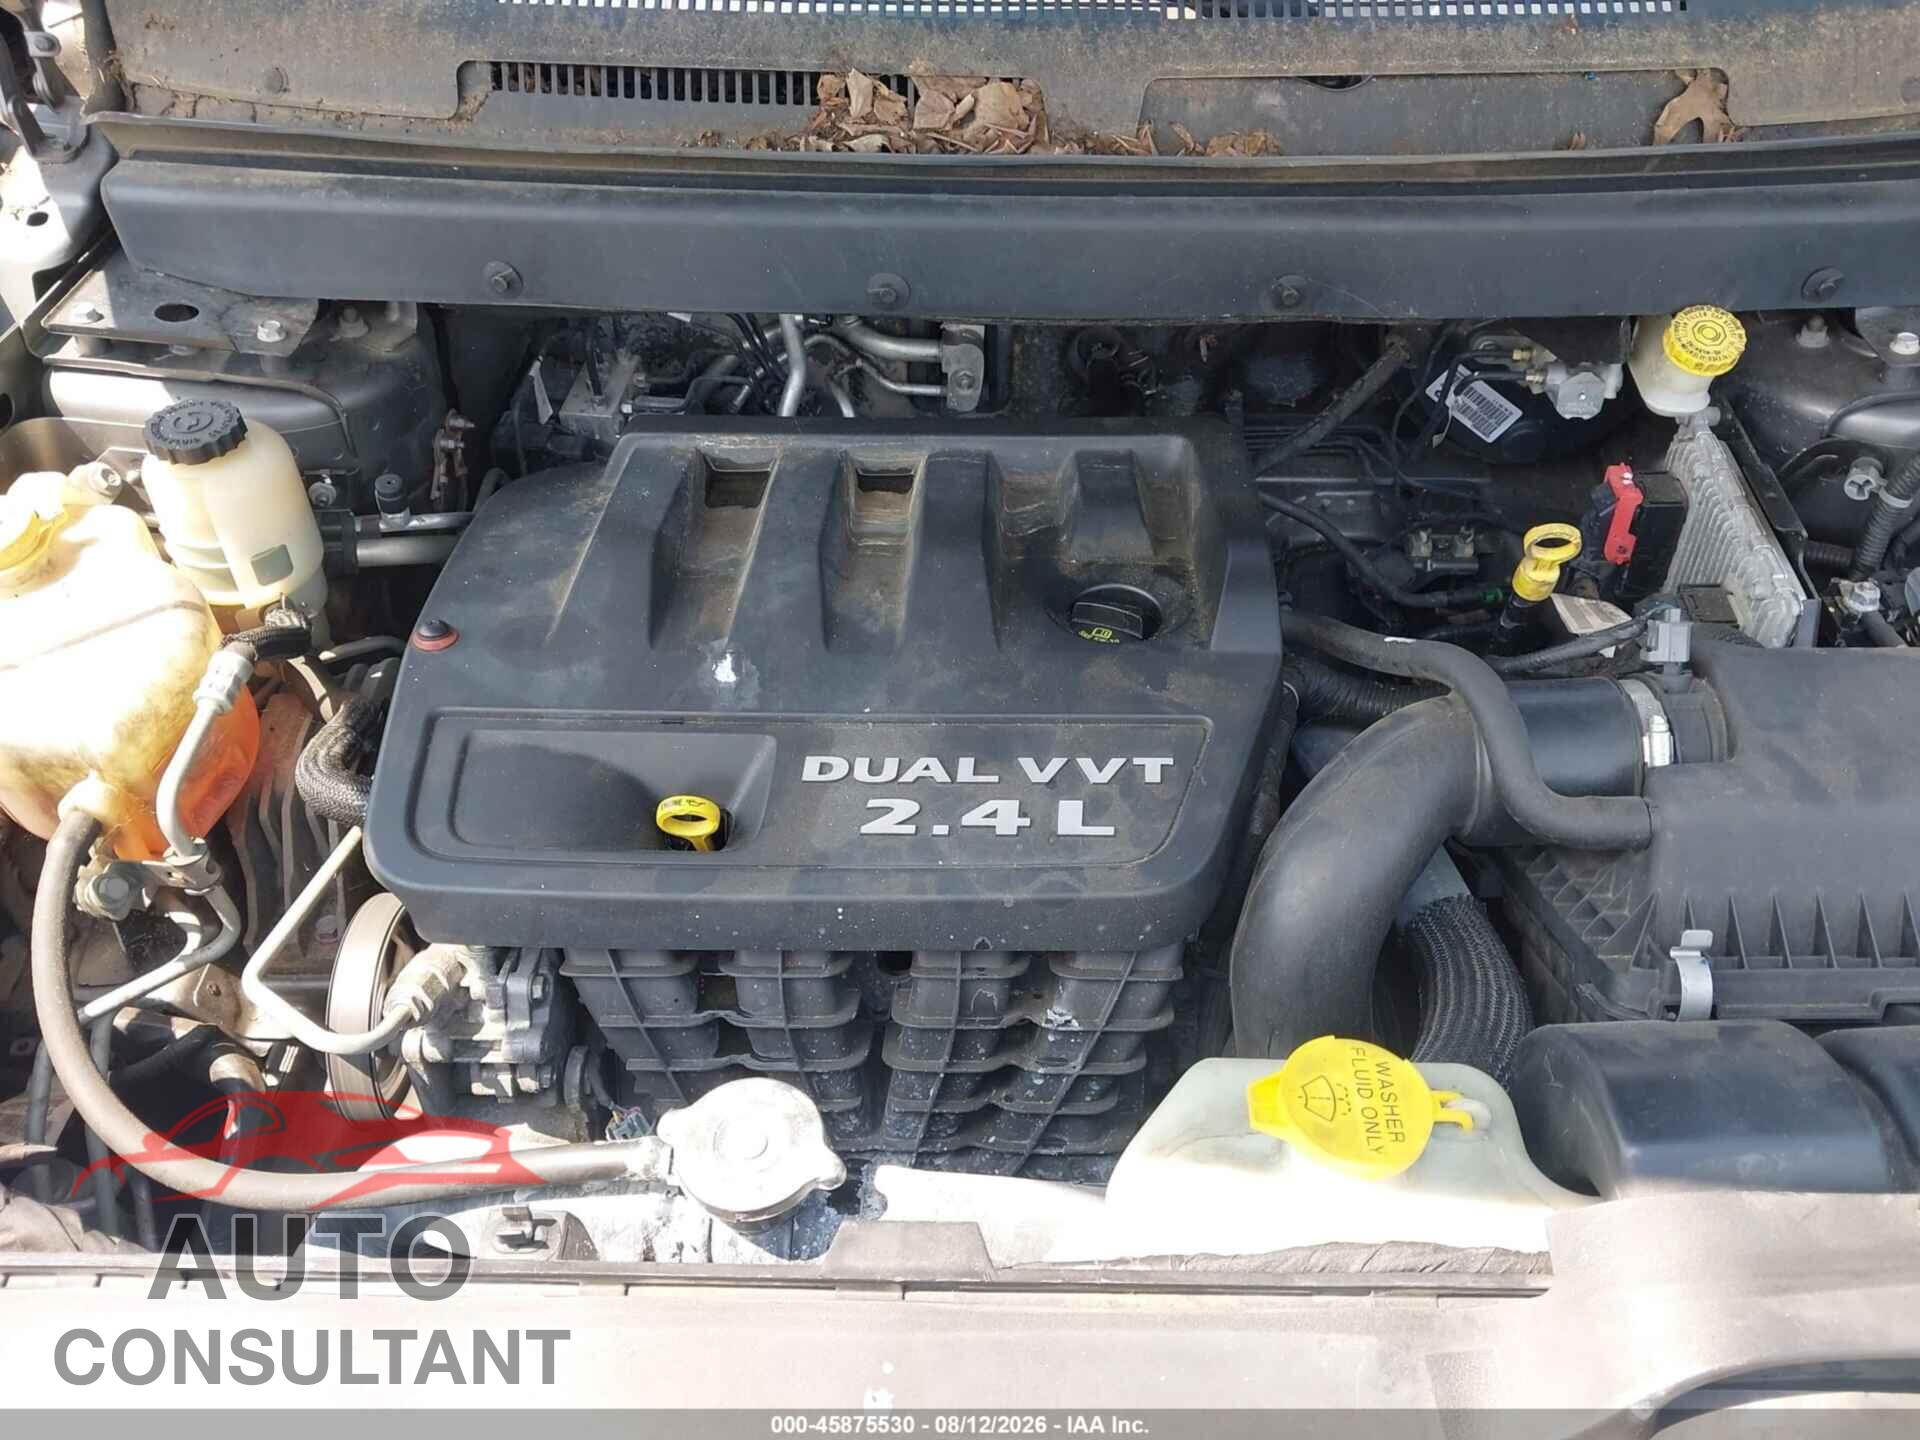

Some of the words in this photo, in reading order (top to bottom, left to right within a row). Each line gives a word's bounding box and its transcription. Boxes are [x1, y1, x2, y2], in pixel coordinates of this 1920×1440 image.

[800, 756, 1000, 784] DUAL
[1017, 757, 1175, 784] VVT
[1351, 1046, 1374, 1100] FLUID
[1375, 1060, 1406, 1144] WASHER
[1360, 1105, 1385, 1155] ONLY
